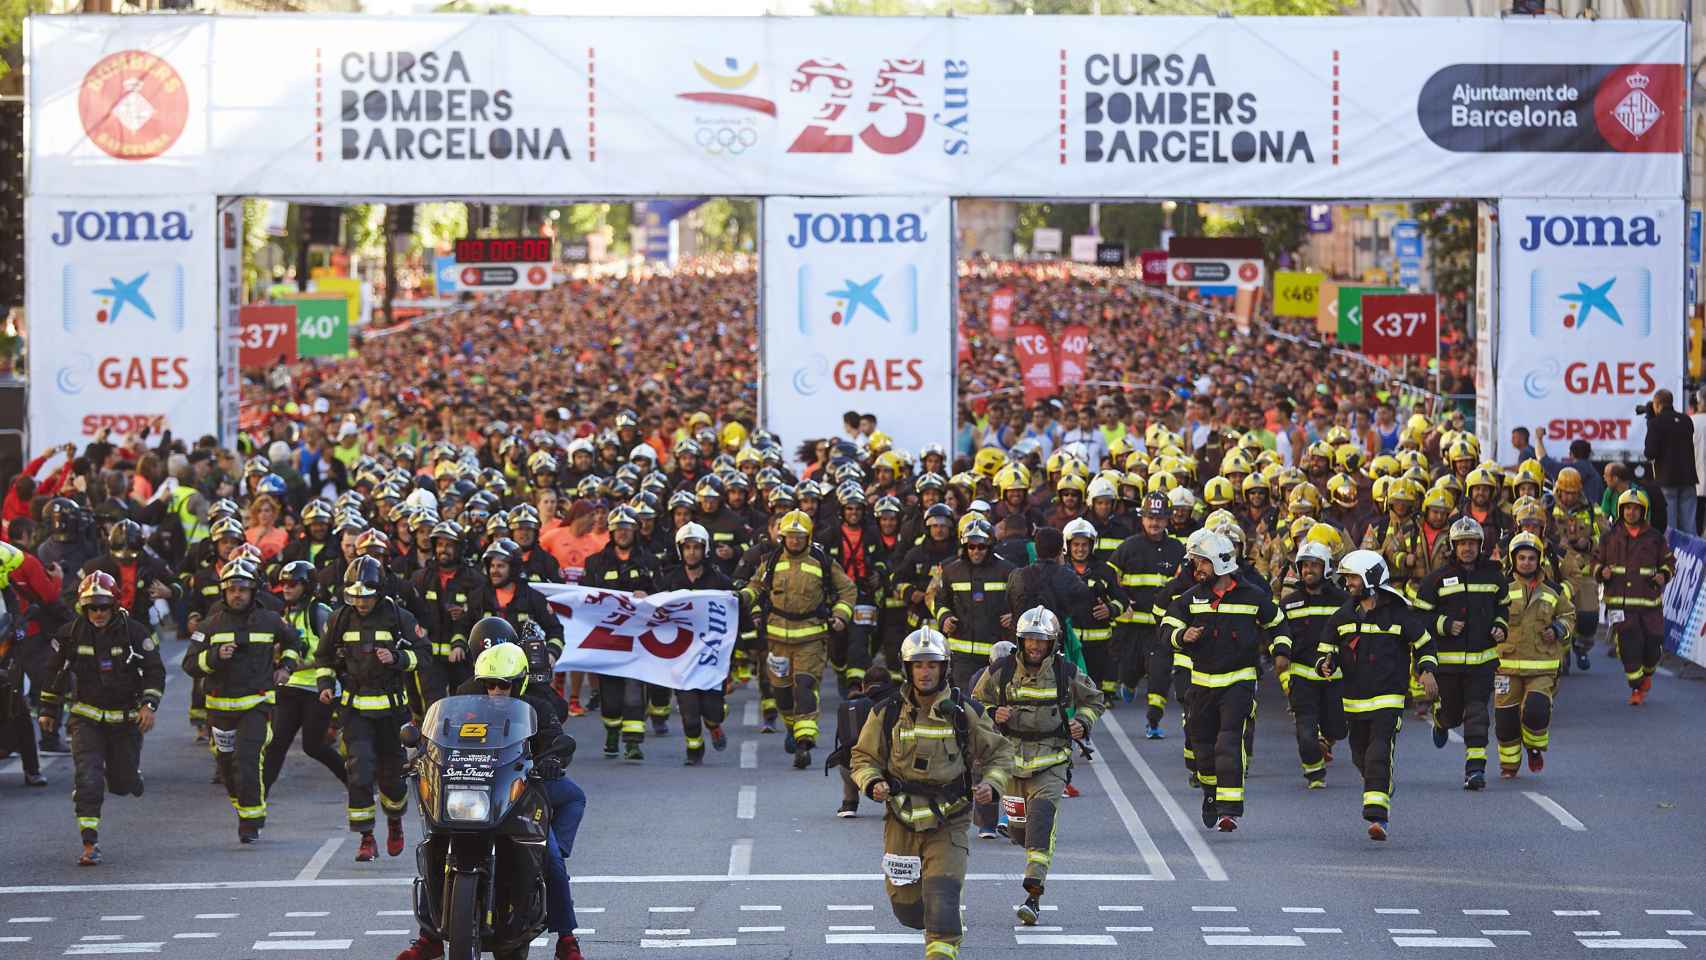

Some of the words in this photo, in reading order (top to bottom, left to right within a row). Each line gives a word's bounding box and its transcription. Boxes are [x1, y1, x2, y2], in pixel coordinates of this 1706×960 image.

[341, 51, 471, 83] CURSA
[1085, 53, 1216, 86] CURSA
[341, 89, 512, 121] BOMBERS
[933, 59, 968, 156] anys
[1085, 92, 1257, 125] BOMBERS
[1452, 84, 1552, 105] Ajuntament
[1556, 83, 1579, 101] de
[1451, 105, 1578, 127] Barcelona
[341, 128, 572, 160] BARCELONA
[1085, 130, 1315, 163] BARCELONA
[1372, 312, 1427, 337] <37'
[98, 357, 190, 389] GAES
[833, 359, 923, 391] GAES
[1564, 361, 1656, 394] GAES
[1548, 418, 1631, 441] SPORT
[699, 600, 727, 667] anys
